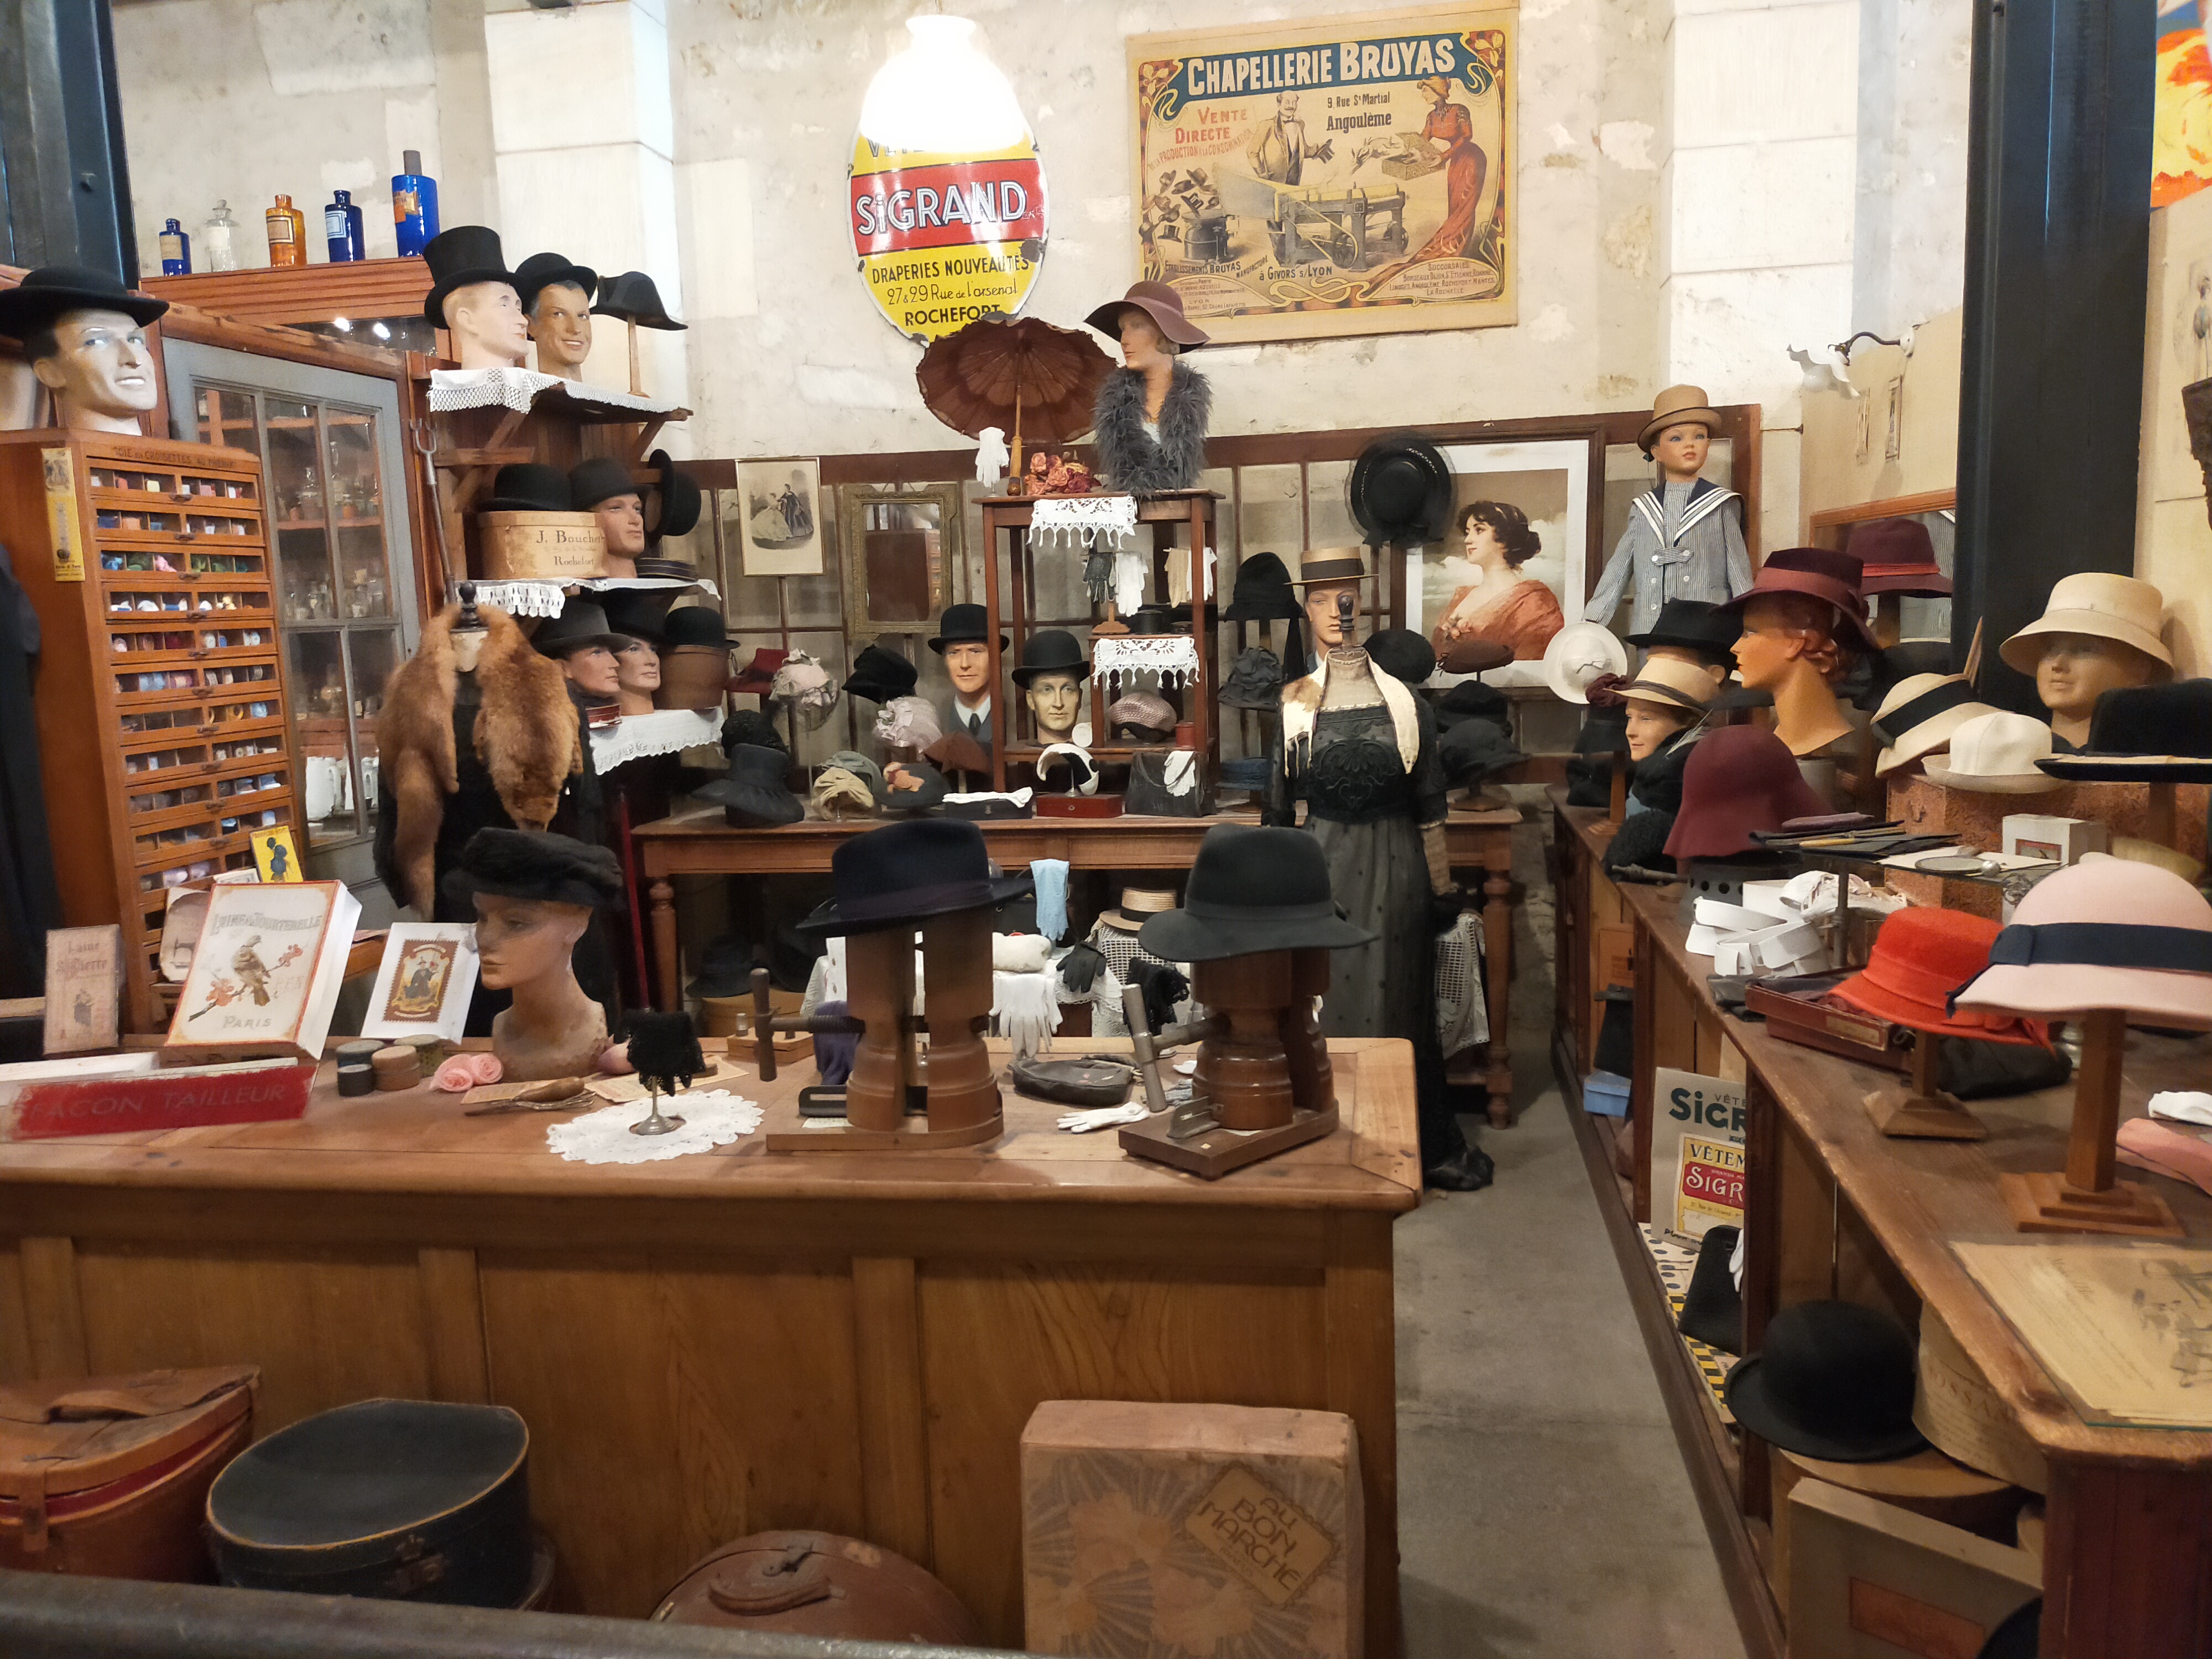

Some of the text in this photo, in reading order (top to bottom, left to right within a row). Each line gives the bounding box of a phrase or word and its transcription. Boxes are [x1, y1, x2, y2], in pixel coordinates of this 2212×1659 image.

[1188, 39, 1455, 96] CHAPELLERIE BRUYAS
[1337, 96, 1350, 108] Rue
[1362, 91, 1390, 105] Martial
[1197, 107, 1248, 124] VENTE
[1175, 127, 1230, 144] DIRECTE
[1159, 145, 1198, 163] PRODUCTION
[1208, 127, 1254, 156] CONSOMMATION
[872, 261, 940, 284] DRAPERIES
[1210, 261, 1241, 274] BRUYAS
[1236, 255, 1268, 279] MANUFACTURE
[1267, 266, 1296, 280] GIVORS
[931, 284, 953, 300] Rue
[956, 290, 966, 299] de
[536, 530, 547, 543] J.
[554, 556, 594, 566] Rochefort
[222, 1015, 272, 1029] PARIS
[162, 1084, 286, 1112] TAILLEUR
[1259, 1498, 1297, 1531] AU
[1232, 1497, 1297, 1558] BON
